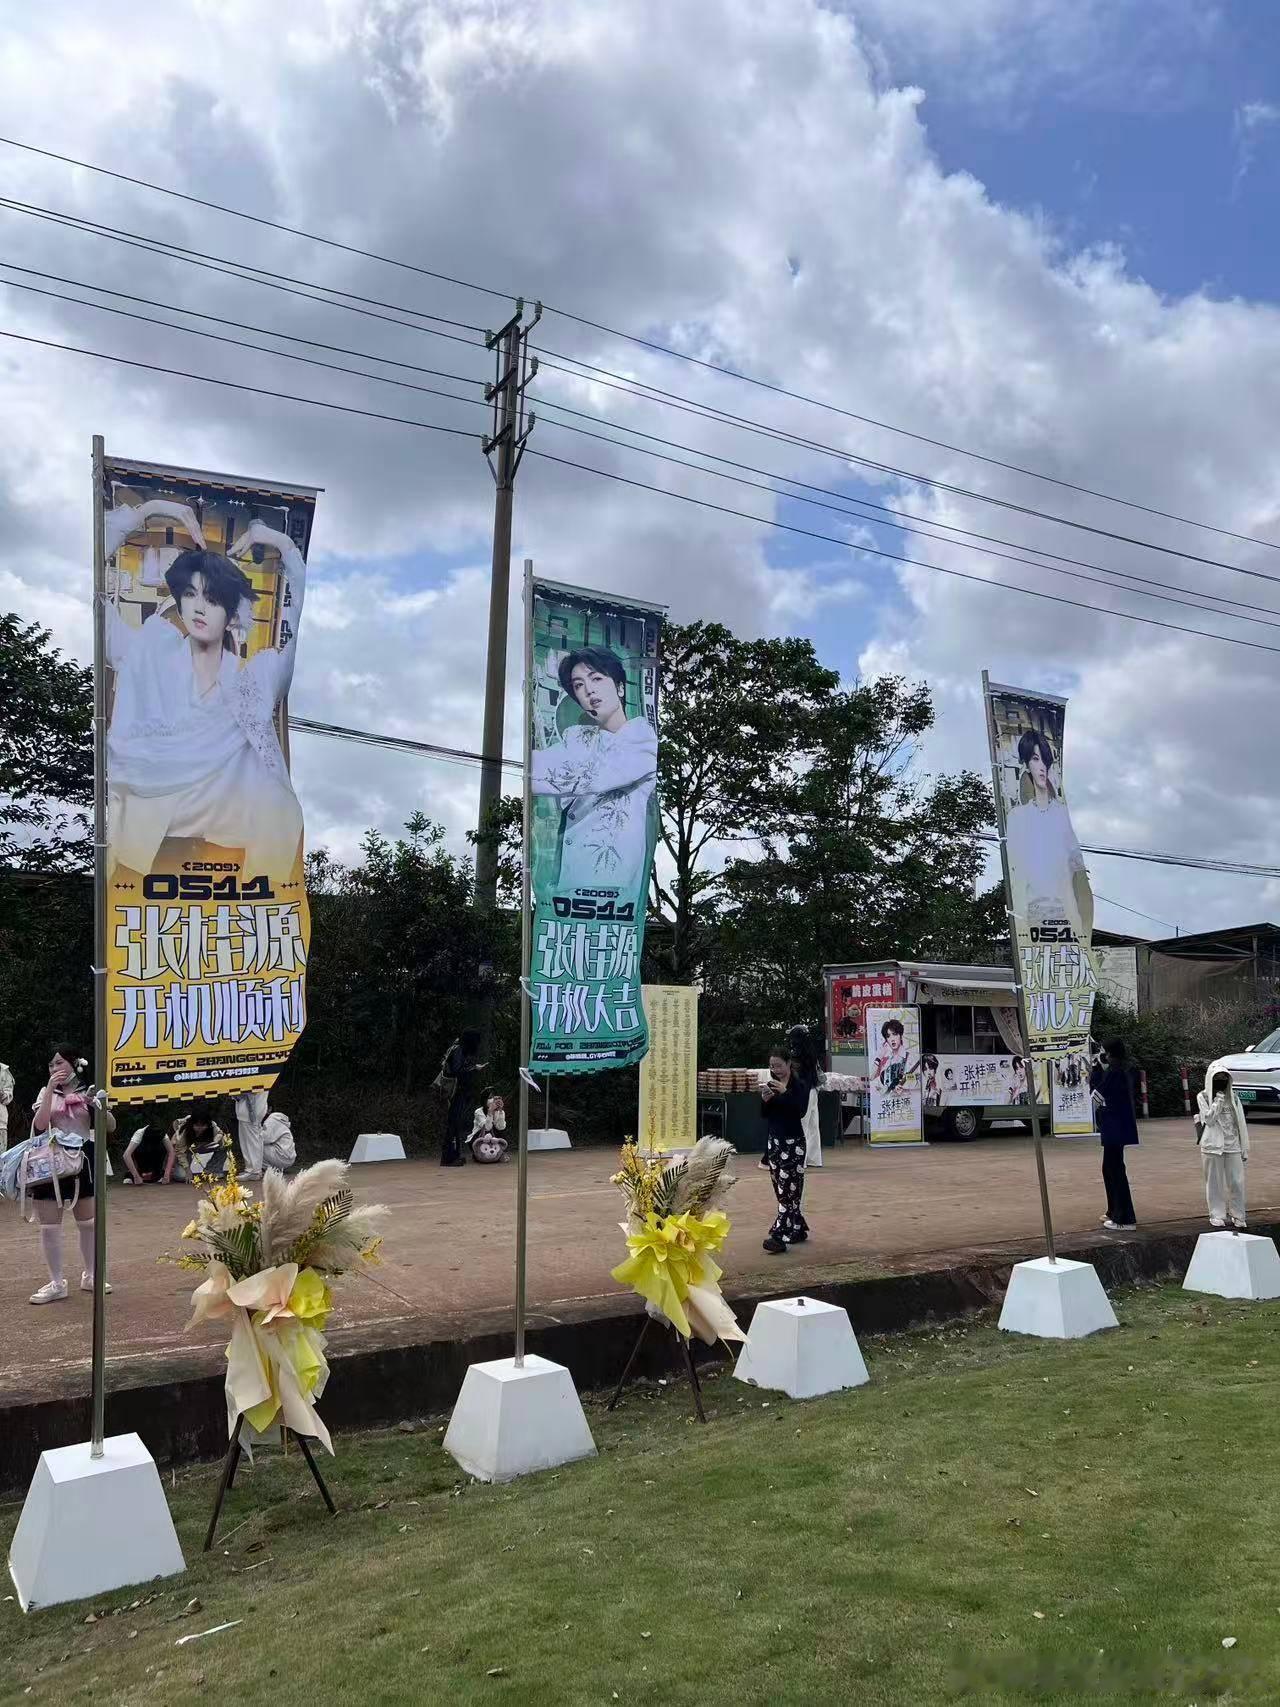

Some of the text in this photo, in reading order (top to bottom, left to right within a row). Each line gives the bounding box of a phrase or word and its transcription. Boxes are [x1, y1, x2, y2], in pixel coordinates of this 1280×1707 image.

[114, 901, 306, 981] 张桂源
[536, 918, 639, 981] 张桂源
[112, 973, 306, 1052] 开机顺利
[532, 981, 640, 1035] 开机大吉
[114, 1061, 146, 1073] ALL
[155, 1058, 187, 1070] FOR
[554, 1042, 573, 1050] FOR
